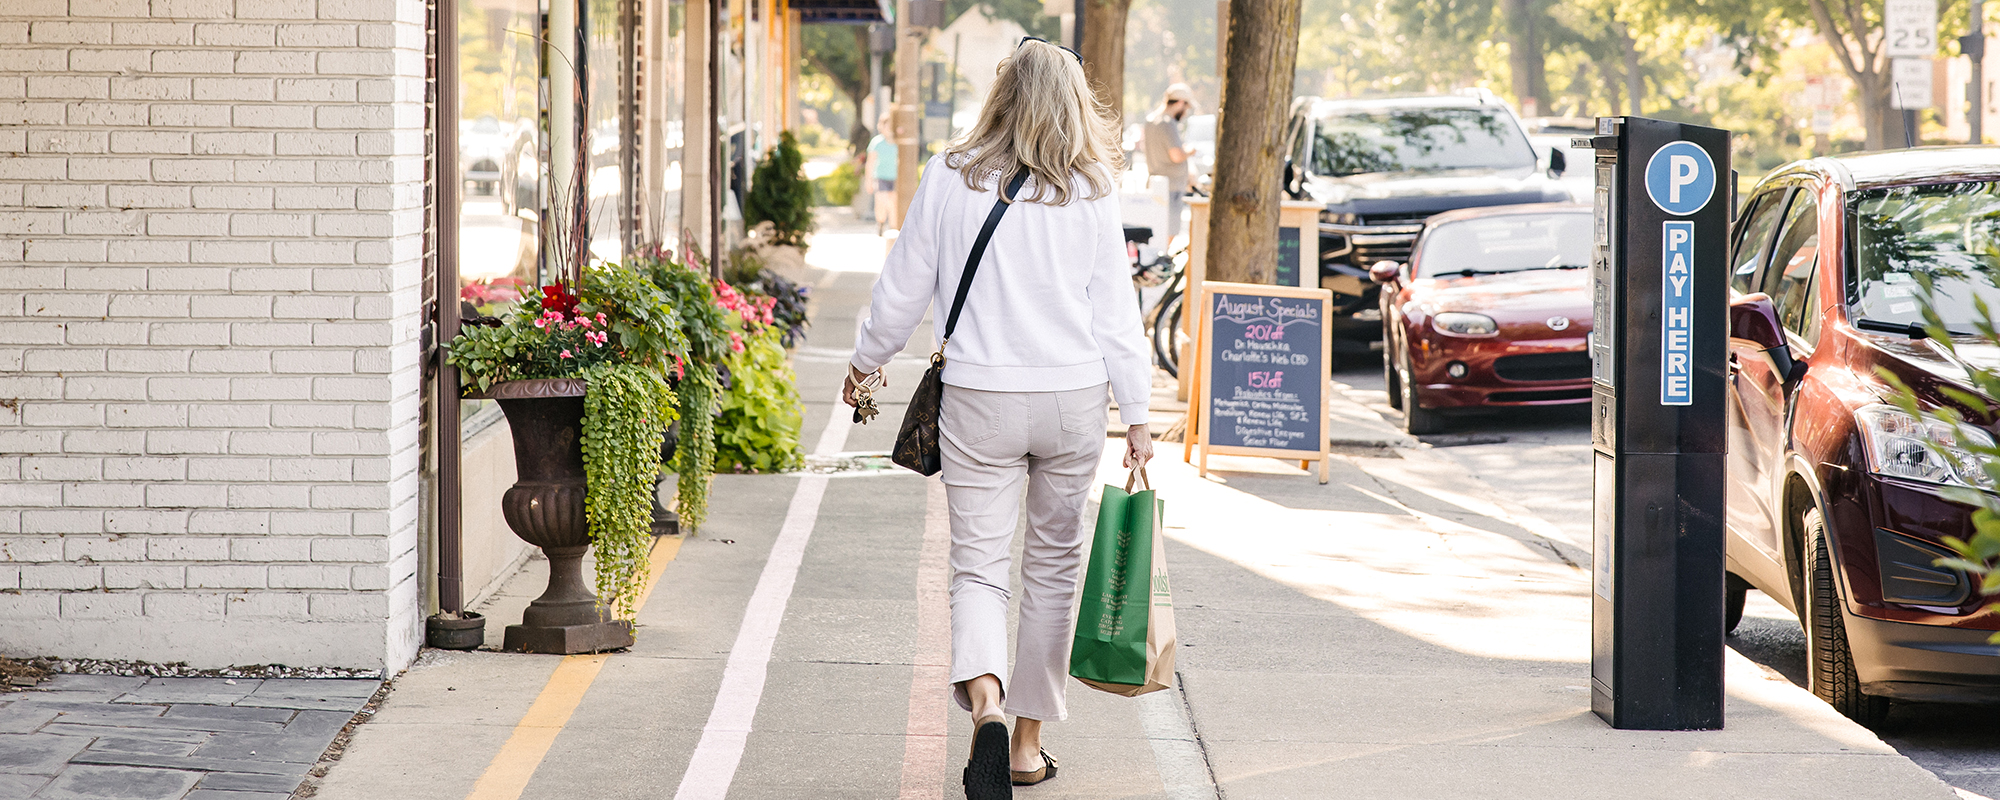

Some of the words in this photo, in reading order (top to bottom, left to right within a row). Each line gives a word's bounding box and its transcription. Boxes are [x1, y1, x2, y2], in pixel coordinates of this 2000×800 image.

[1893, 27, 1931, 49] 25
[1669, 155, 1699, 203] P
[1669, 229, 1688, 297] PAY
[1215, 294, 1265, 320] August
[1266, 298, 1318, 325] Specials
[1221, 349, 1268, 363] Charlotte's
[1270, 352, 1290, 365] Web
[1290, 353, 1309, 366] CBD
[1247, 339, 1291, 352] Hauschka
[1667, 307, 1688, 397] HERE
